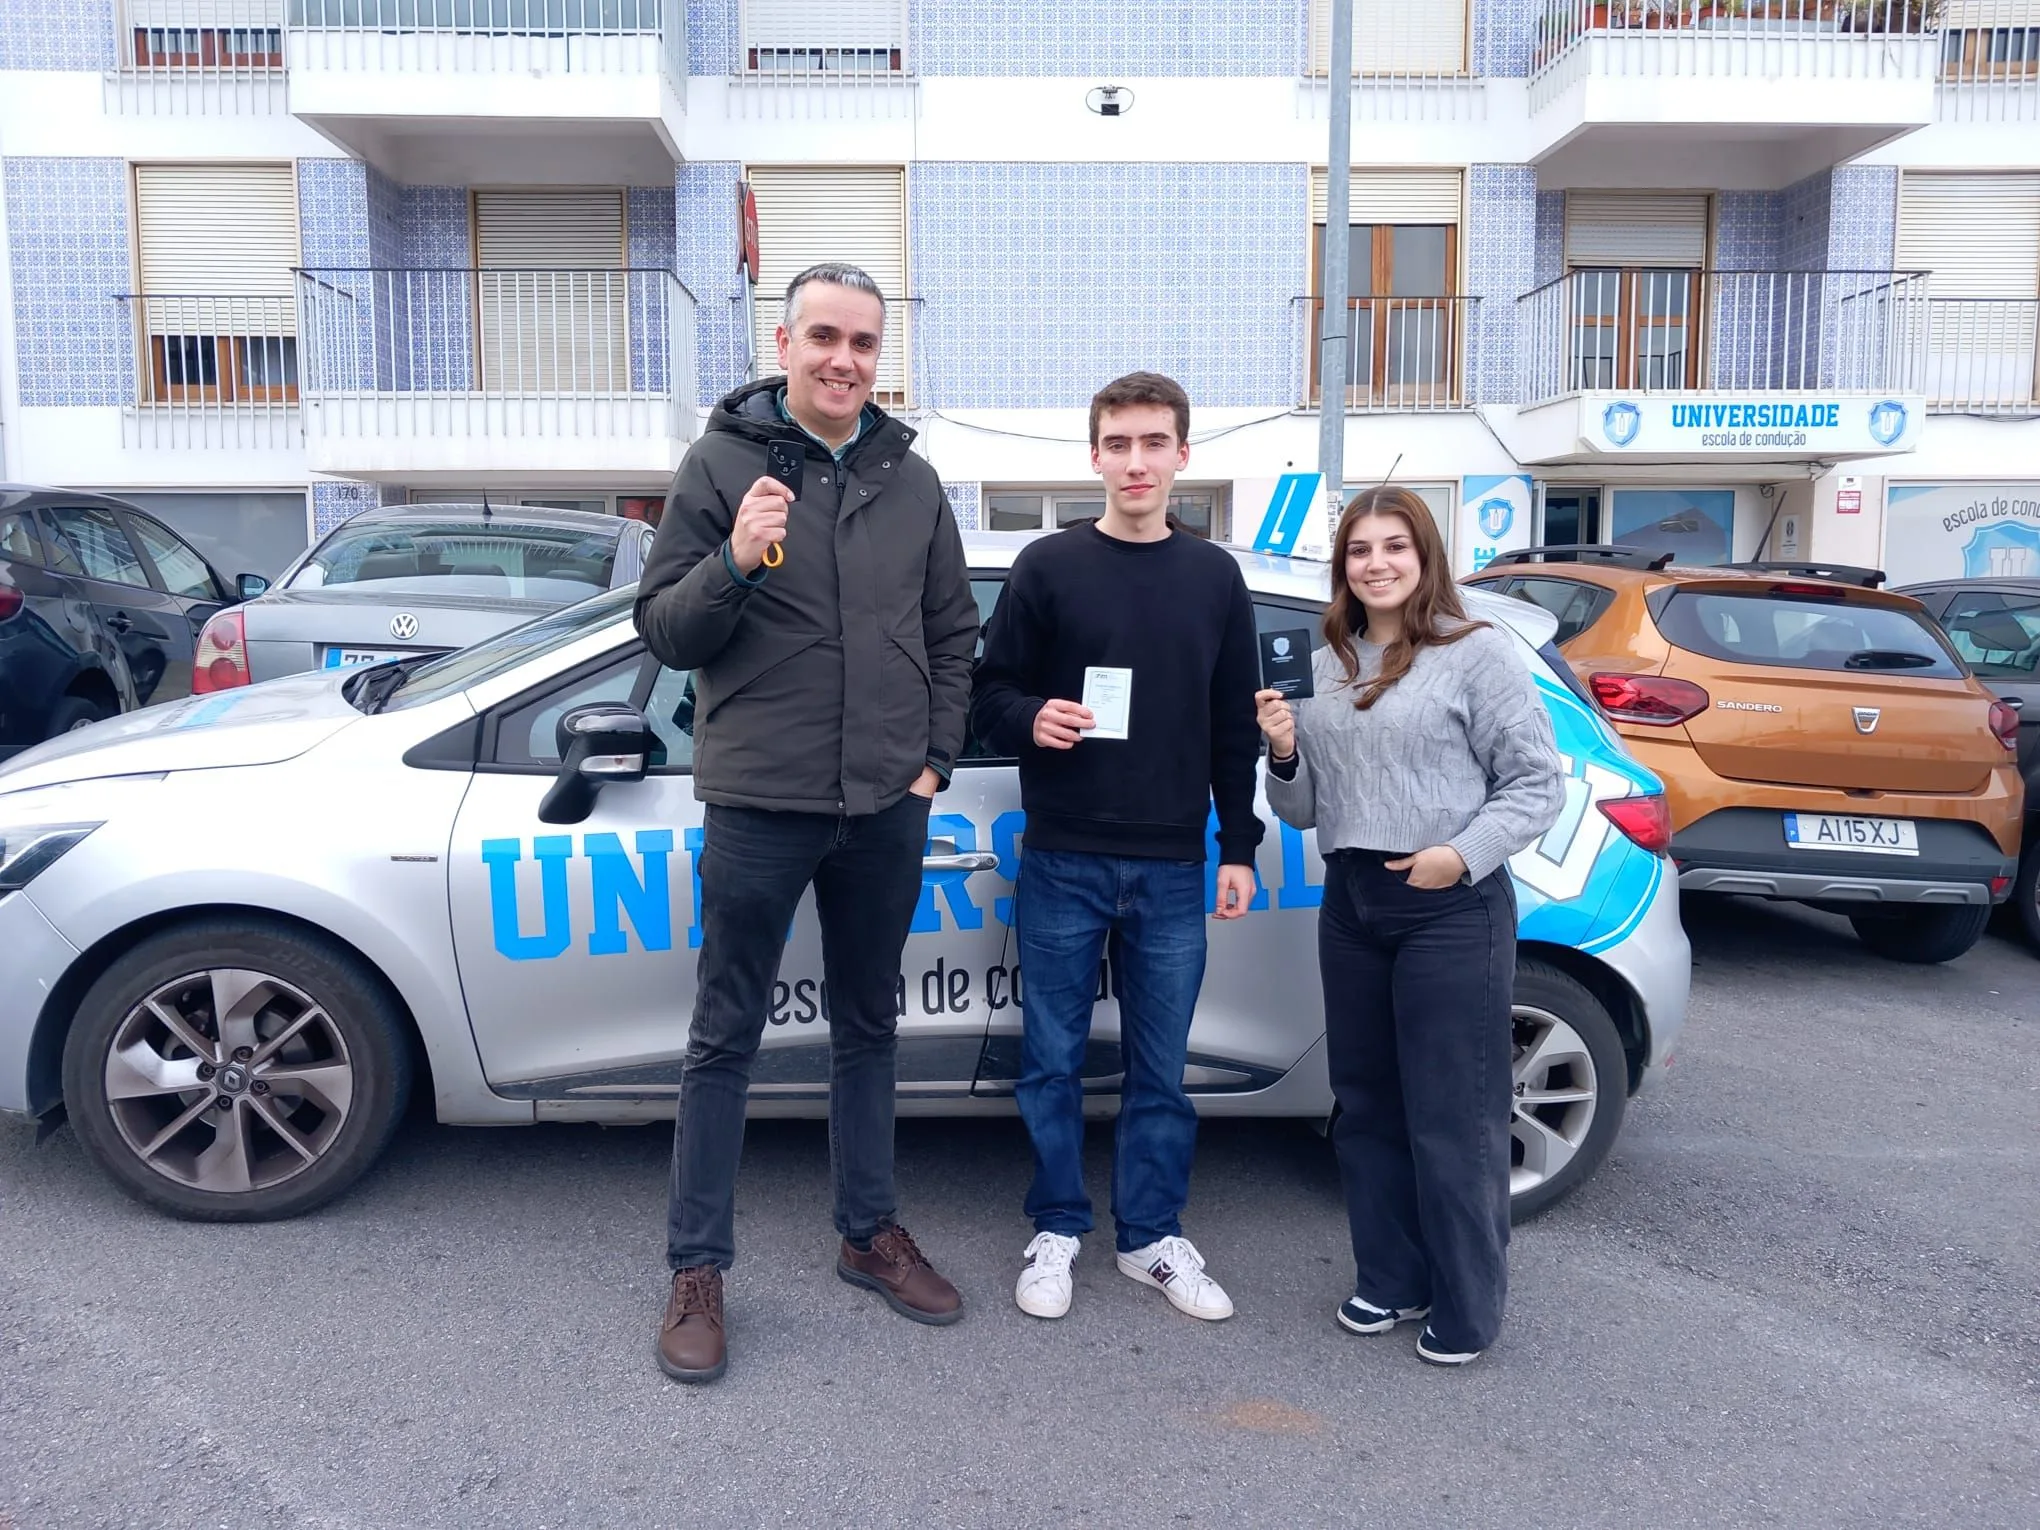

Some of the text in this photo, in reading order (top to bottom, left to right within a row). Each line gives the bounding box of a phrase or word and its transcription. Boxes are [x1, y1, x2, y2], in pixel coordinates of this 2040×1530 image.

[1672, 404, 1840, 428] UNIVERSIDADE
[1702, 430, 1807, 448] escola de condução
[337, 486, 359, 500] 170
[1942, 500, 1988, 533] escola
[1991, 495, 2008, 517] de
[1716, 701, 1783, 714] SANDERO
[922, 957, 970, 1014] de
